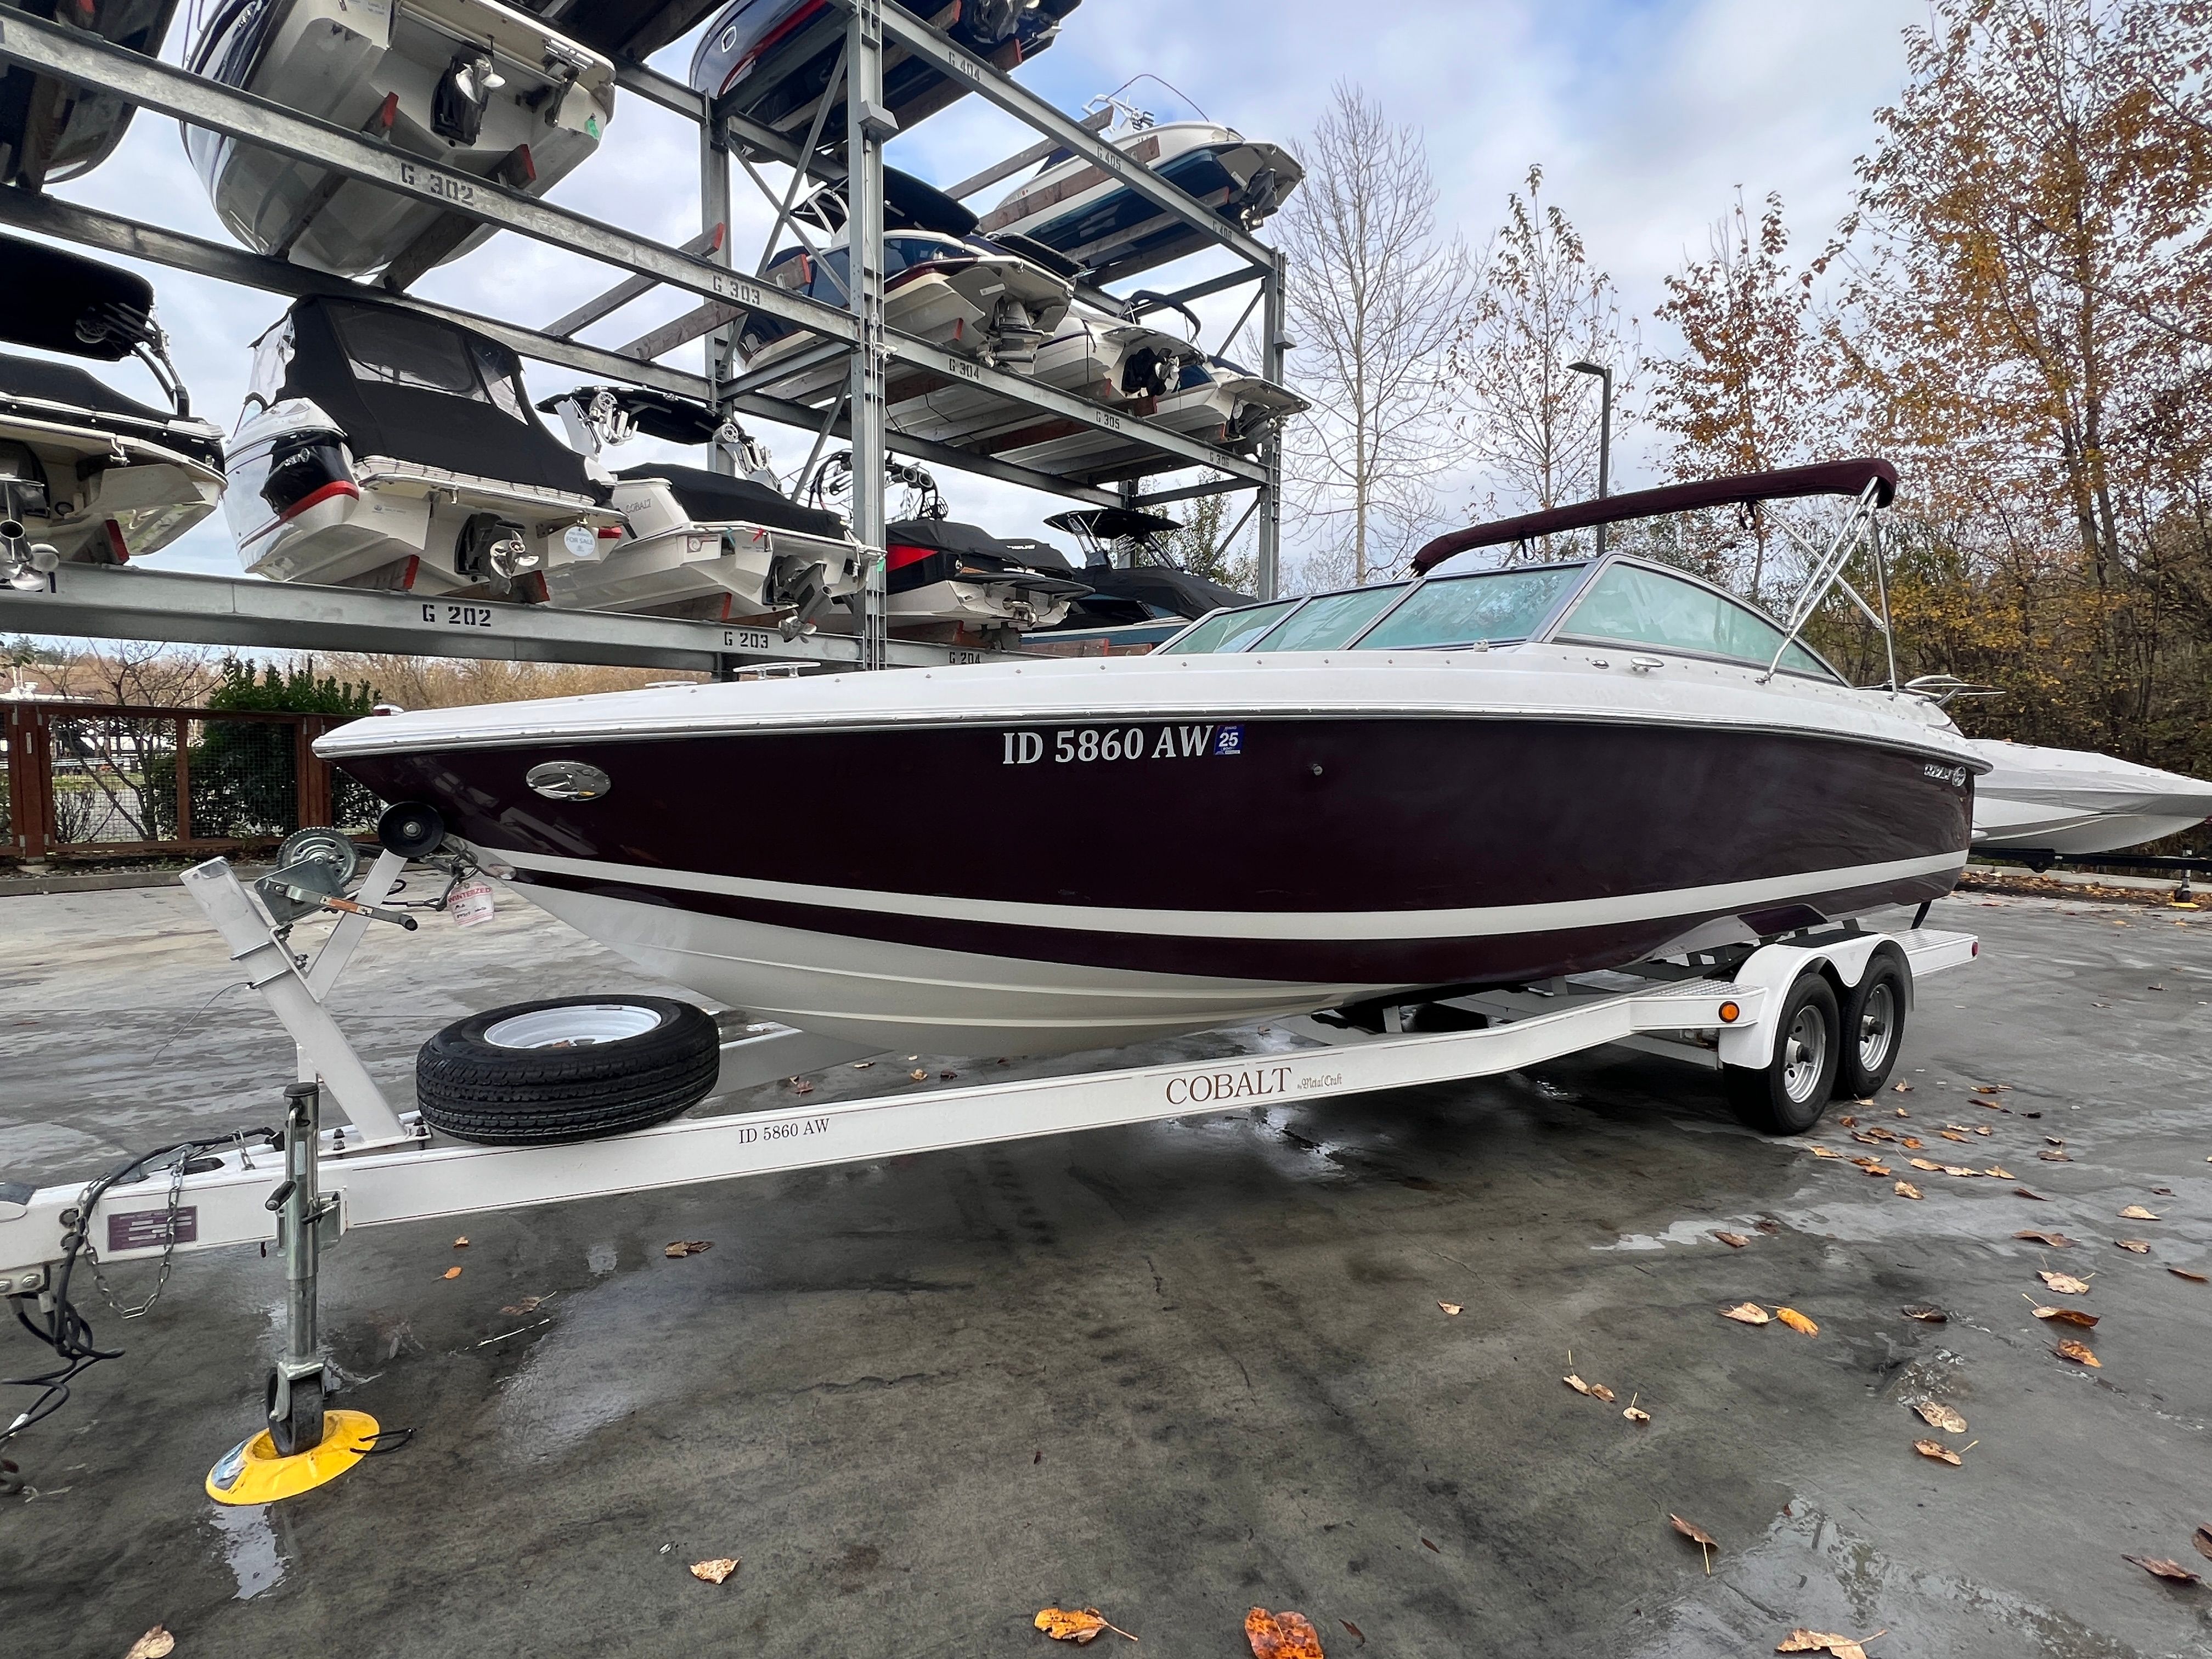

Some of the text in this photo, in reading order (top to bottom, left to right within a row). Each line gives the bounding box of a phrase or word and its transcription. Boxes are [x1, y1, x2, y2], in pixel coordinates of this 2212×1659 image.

[949, 51, 980, 81] G 404
[401, 162, 473, 206] G 302
[713, 275, 760, 305] G 303
[949, 358, 979, 380] G 304
[1096, 411, 1120, 430] G 305
[1210, 452, 1214, 462] G
[422, 604, 491, 627] G 202
[724, 631, 768, 648] G 203
[949, 651, 981, 665] G 204
[1002, 725, 1214, 764] ID 5860 AW
[1218, 732, 1239, 747] 25
[447, 887, 492, 904] WINTERIZED
[1166, 1067, 1292, 1105] COBALT
[1324, 1073, 1342, 1086] Craft
[739, 1118, 830, 1144] ID 5860 AW
